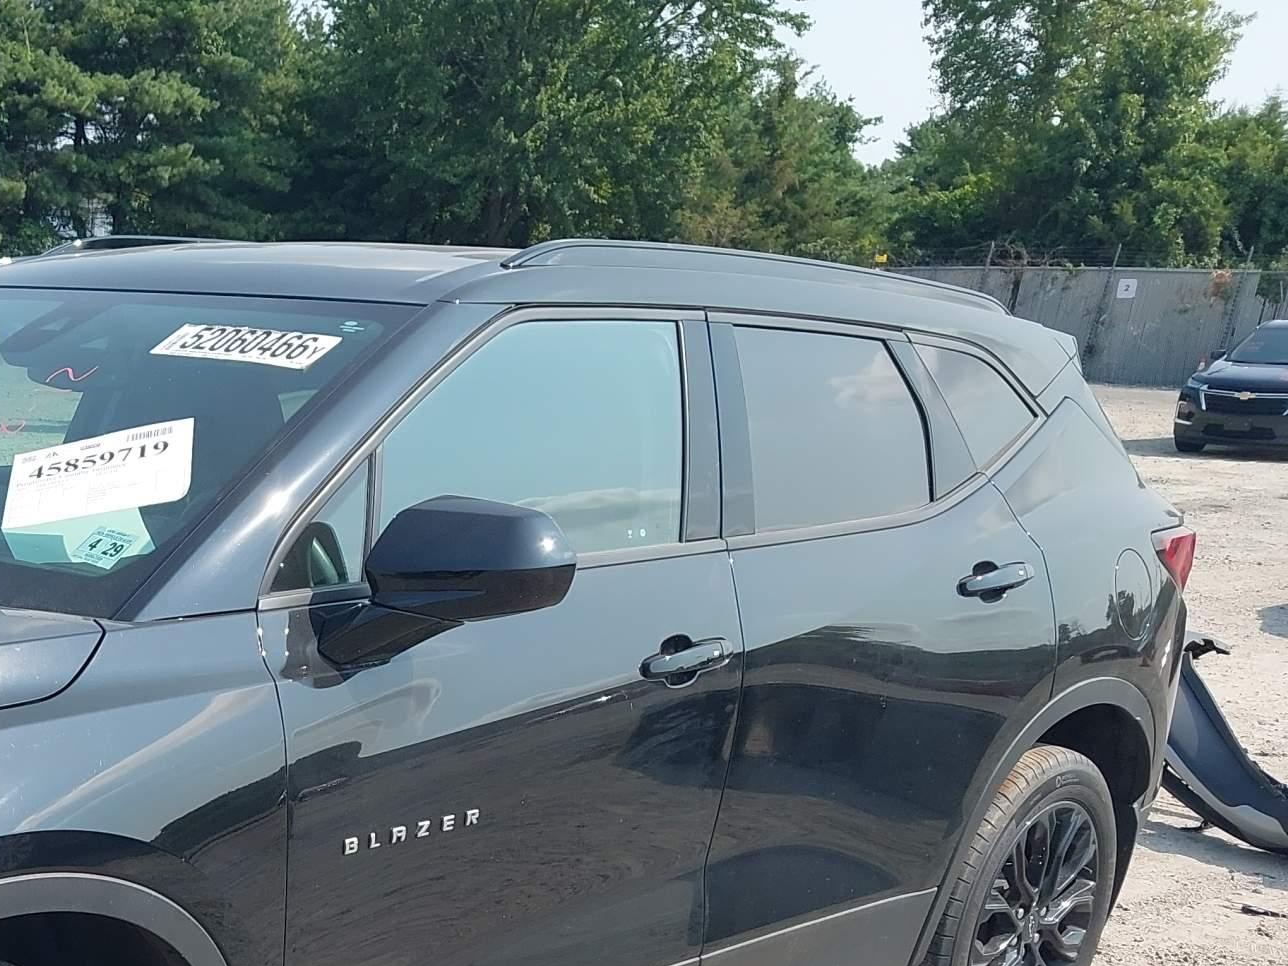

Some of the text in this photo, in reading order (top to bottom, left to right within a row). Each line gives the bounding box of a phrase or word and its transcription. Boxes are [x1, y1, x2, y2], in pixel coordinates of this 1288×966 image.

[180, 327, 319, 360] 52060466
[28, 440, 170, 479] 45859719
[87, 538, 103, 552] 4
[101, 541, 125, 558] 29
[344, 808, 480, 856] BLAZER
